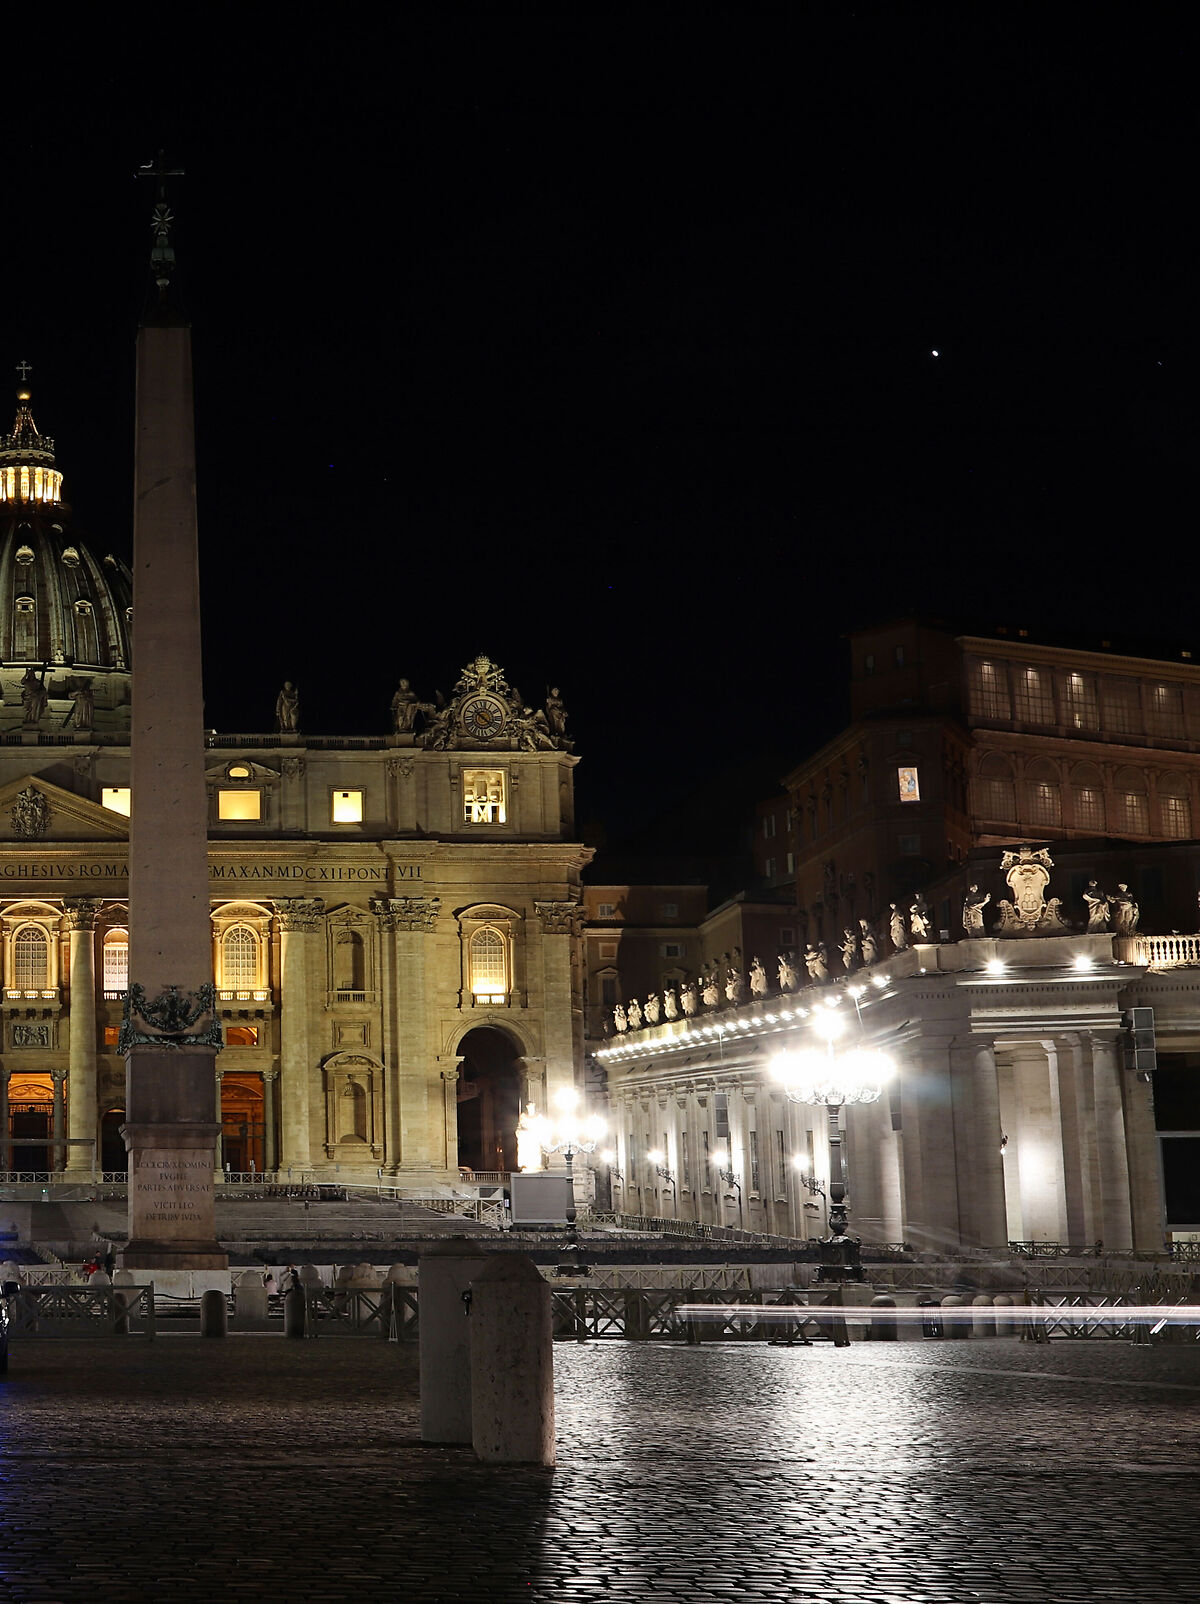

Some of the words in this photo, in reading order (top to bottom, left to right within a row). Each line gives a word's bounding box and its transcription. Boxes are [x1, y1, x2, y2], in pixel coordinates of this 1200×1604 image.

[79, 864, 130, 877] ROMA
[212, 865, 249, 878] MAX
[251, 866, 274, 878] AN
[277, 866, 343, 880] MDCXII
[348, 867, 391, 880] PONT
[398, 866, 421, 878] VII
